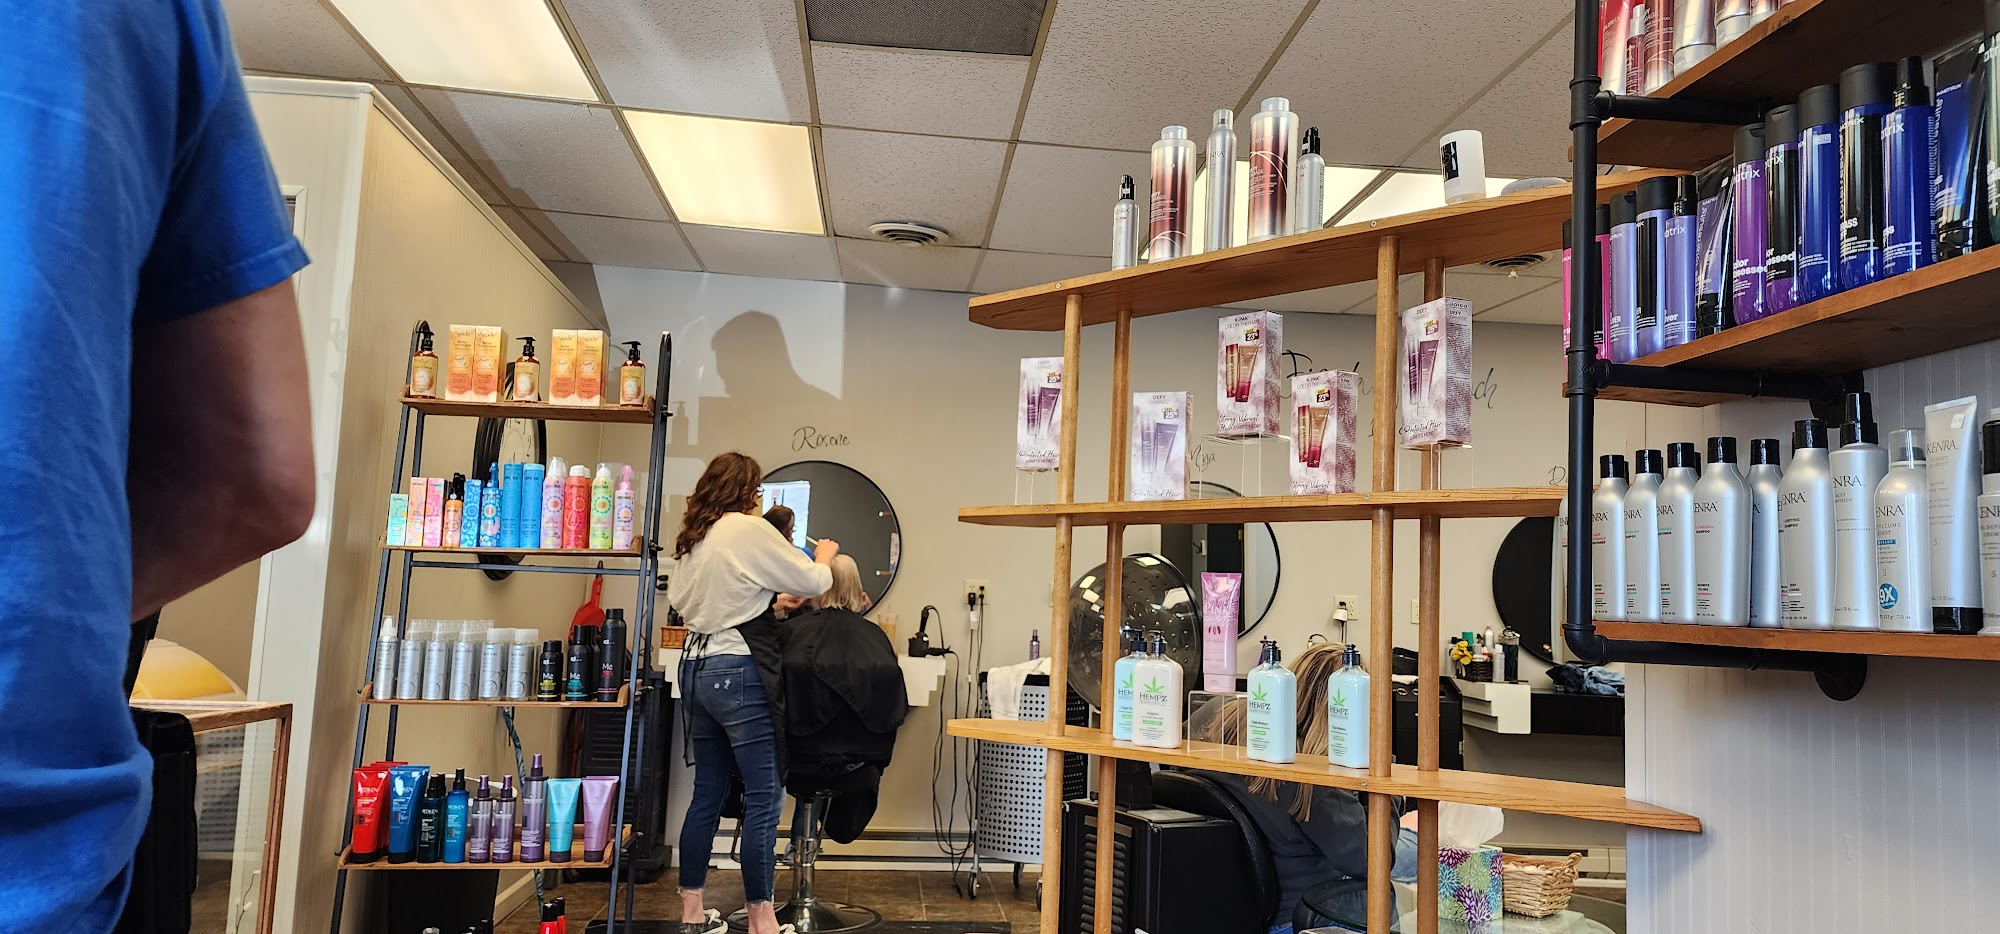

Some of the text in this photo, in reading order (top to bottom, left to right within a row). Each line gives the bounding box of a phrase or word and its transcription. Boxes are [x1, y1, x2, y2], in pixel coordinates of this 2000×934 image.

[1765, 154, 1784, 169] trix
[1733, 168, 1760, 184] atrix
[1664, 225, 1687, 238] atrix
[1926, 439, 1957, 454] KENRA
[1782, 492, 1806, 505] ENRA
[1624, 509, 1642, 520] ENRA
[1876, 505, 1905, 518] ENRA
[1592, 512, 1609, 522] NRA
[1933, 538, 1938, 546] 5
[1882, 568, 1887, 576] 3
[1991, 570, 1997, 578] 5
[1204, 603, 1230, 615] PINK
[1118, 688, 1133, 696] HEM
[1139, 692, 1168, 702] HEMPZ
[1249, 701, 1271, 711] HEMPZ
[1330, 705, 1349, 715] HEMPZ
